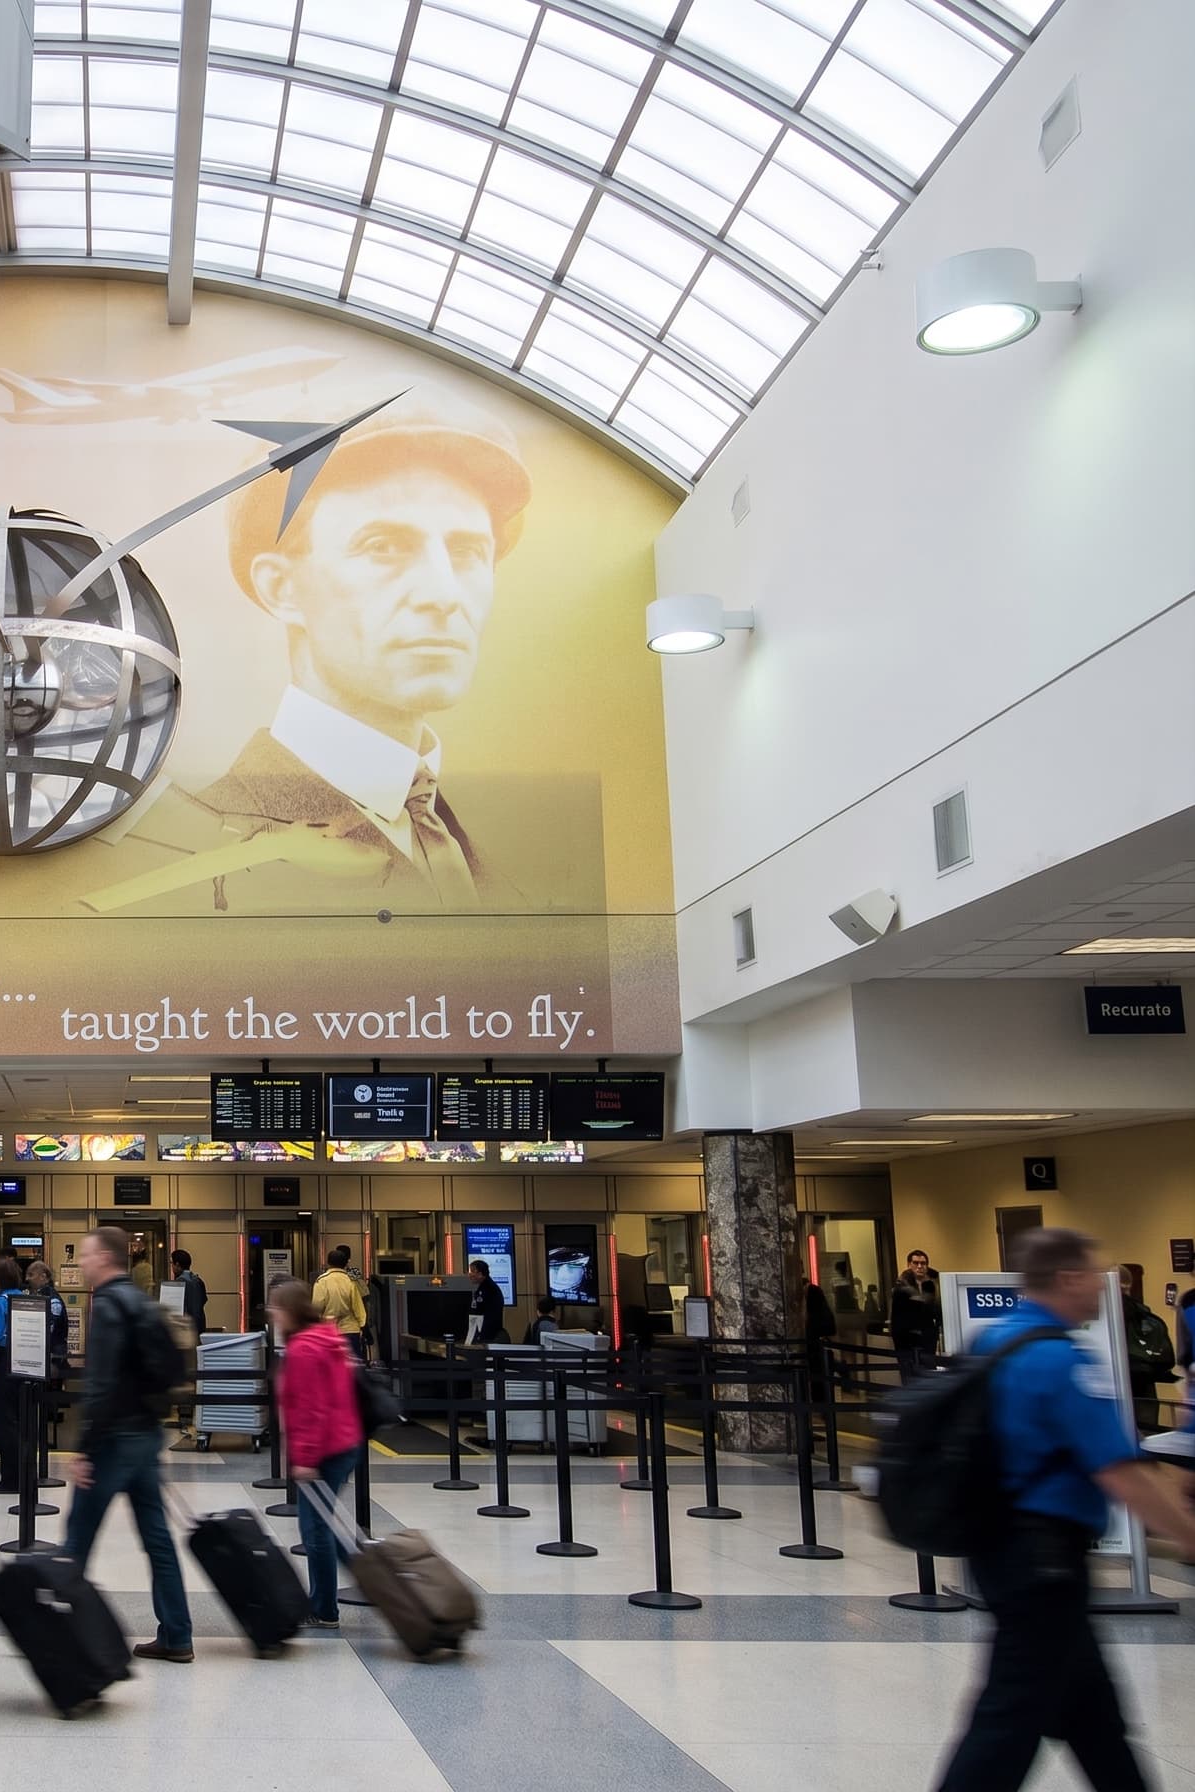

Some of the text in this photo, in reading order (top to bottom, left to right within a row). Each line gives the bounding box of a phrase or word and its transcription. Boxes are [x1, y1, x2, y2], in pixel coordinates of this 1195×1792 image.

[60, 993, 595, 1053] taught the world to fly.
